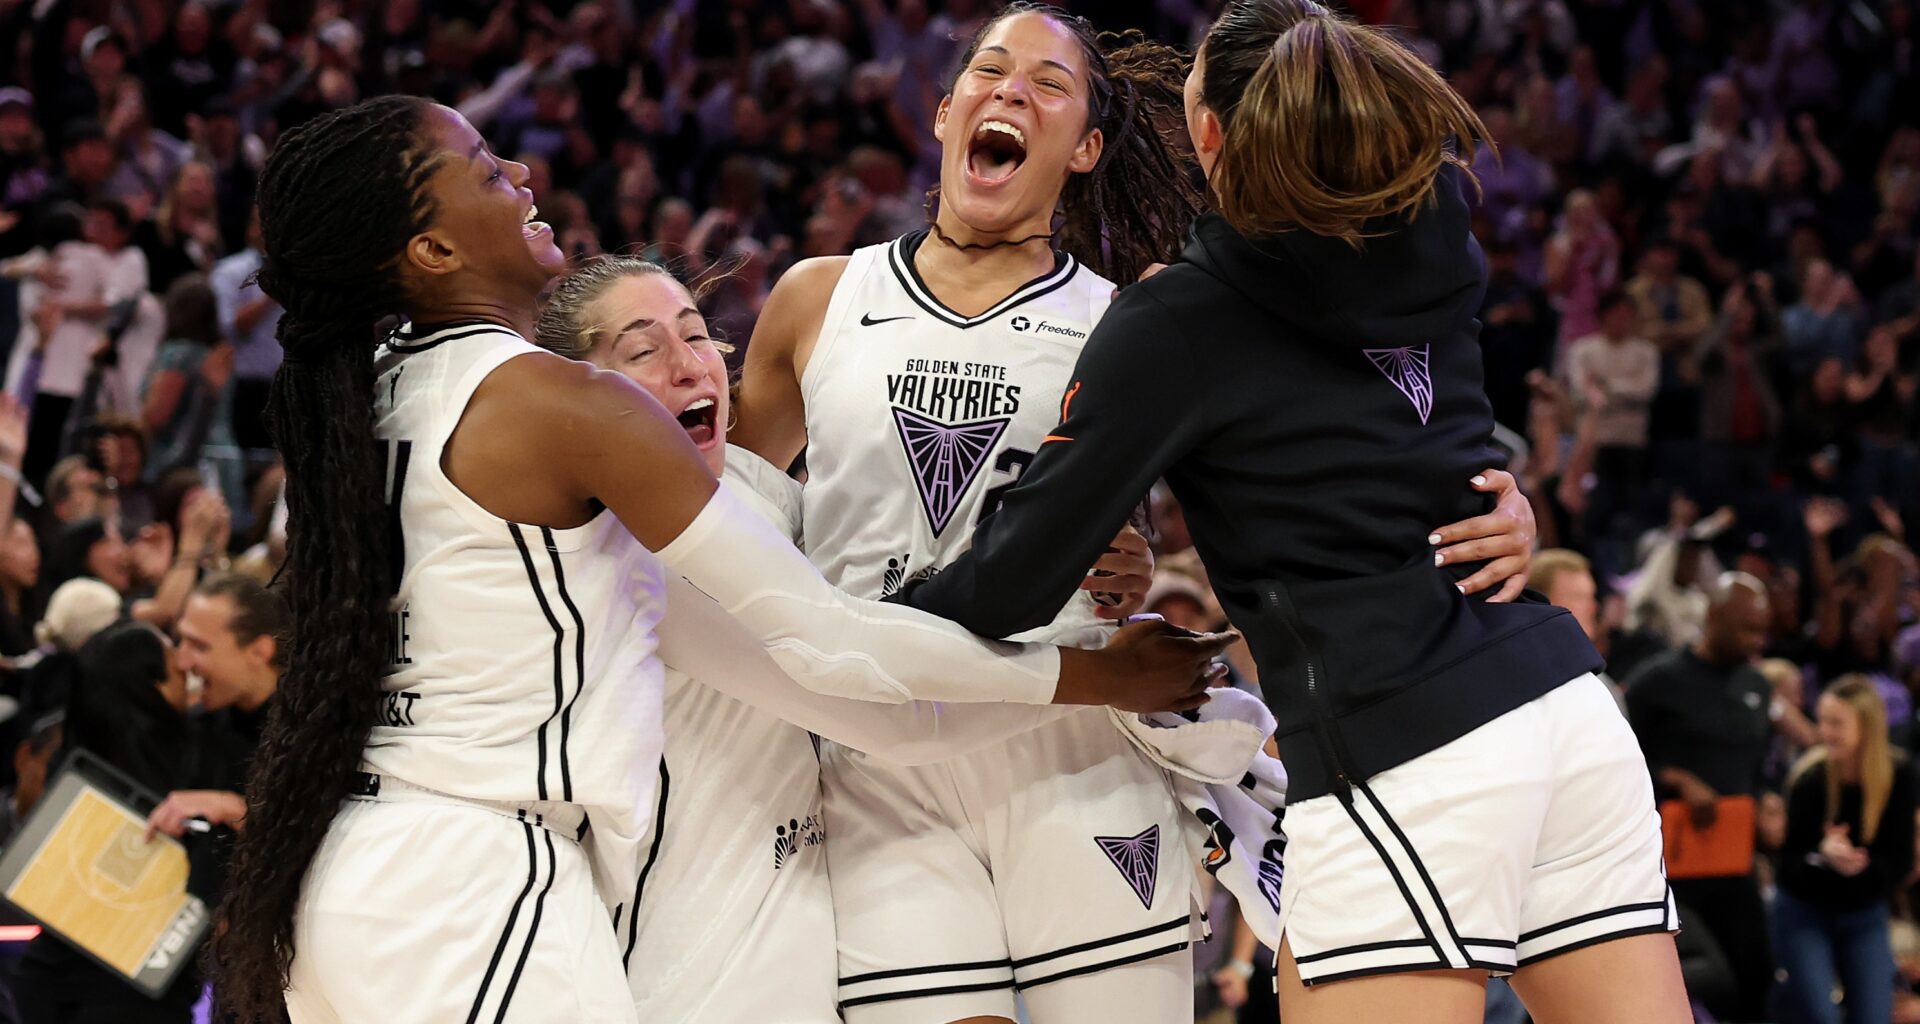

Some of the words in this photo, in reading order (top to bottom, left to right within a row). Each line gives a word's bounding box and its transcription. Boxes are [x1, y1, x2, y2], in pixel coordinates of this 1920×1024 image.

[1035, 321, 1086, 339] freedom
[906, 359, 959, 375] GOLDEN
[964, 363, 1006, 381] STATE
[887, 374, 1021, 422] VALKYRIES
